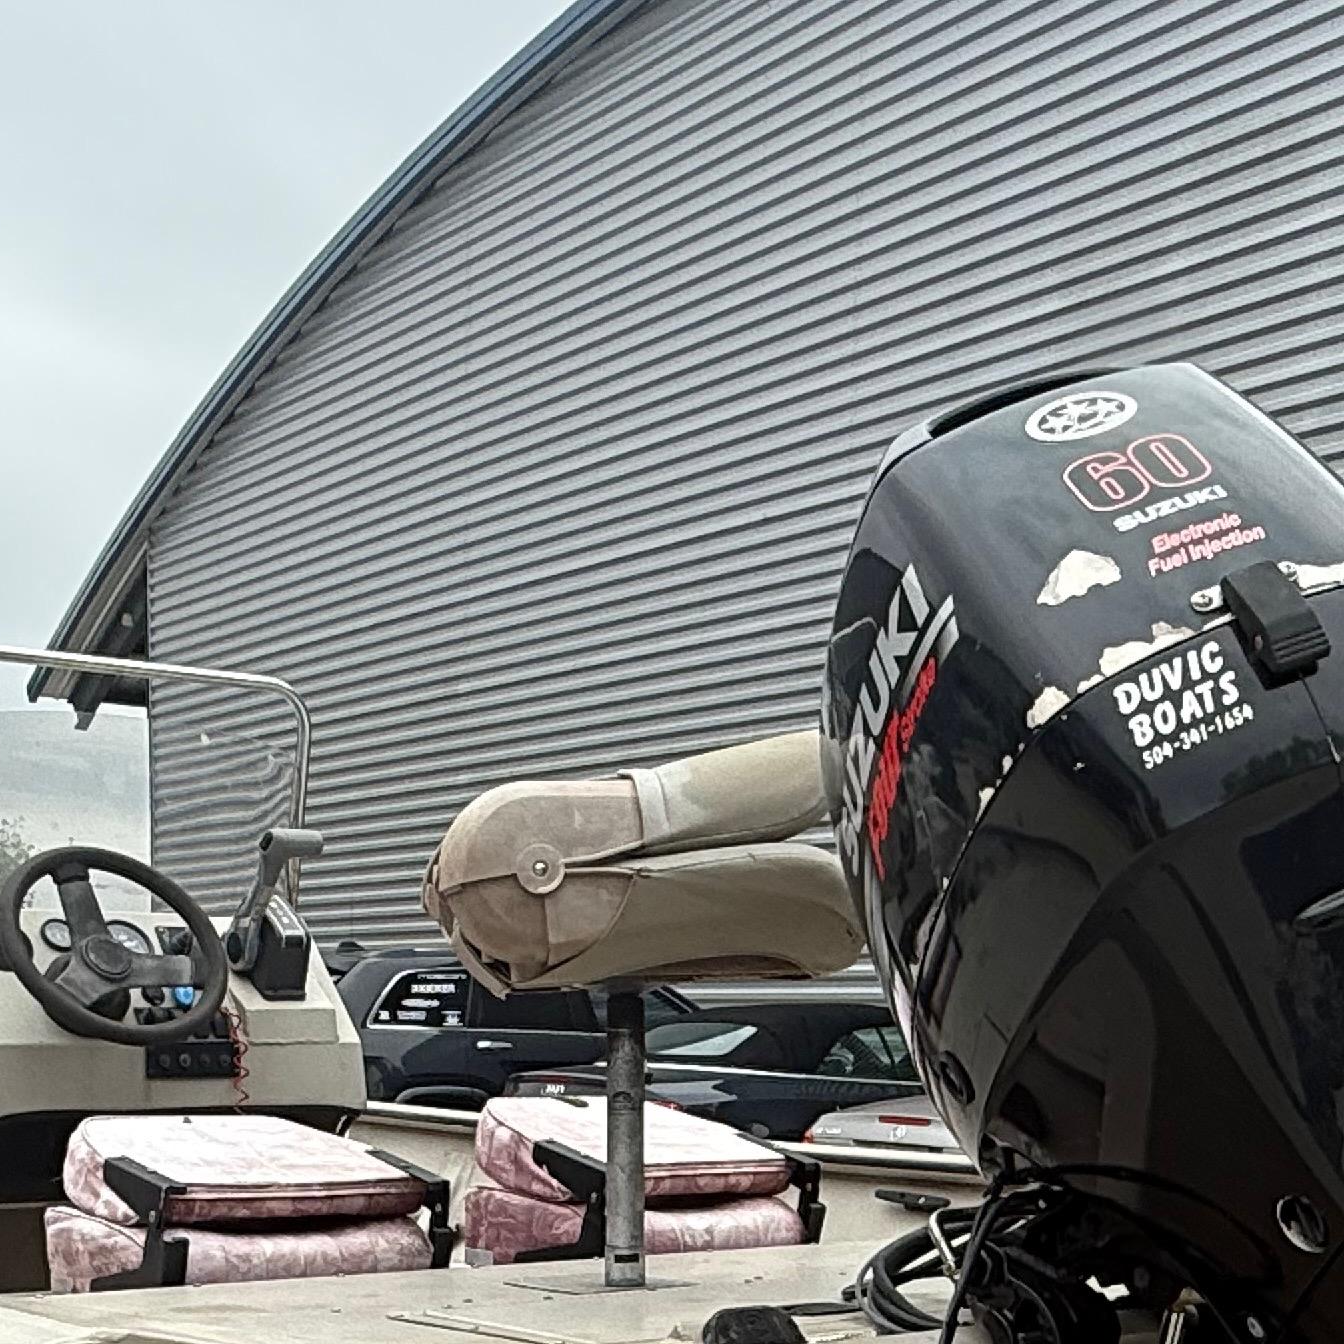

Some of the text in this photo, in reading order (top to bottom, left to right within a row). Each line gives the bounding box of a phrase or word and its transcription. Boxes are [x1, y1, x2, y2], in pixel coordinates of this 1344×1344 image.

[1062, 433, 1212, 511] 60
[1112, 484, 1228, 532] SUZUKI
[1151, 512, 1242, 552] Electronic
[1147, 526, 1266, 578] Fuel Injection
[1112, 640, 1224, 715] DUVIC
[1128, 670, 1240, 747] BOATS
[840, 563, 930, 877] SUZUKI
[1142, 703, 1254, 770] 504-341-1654
